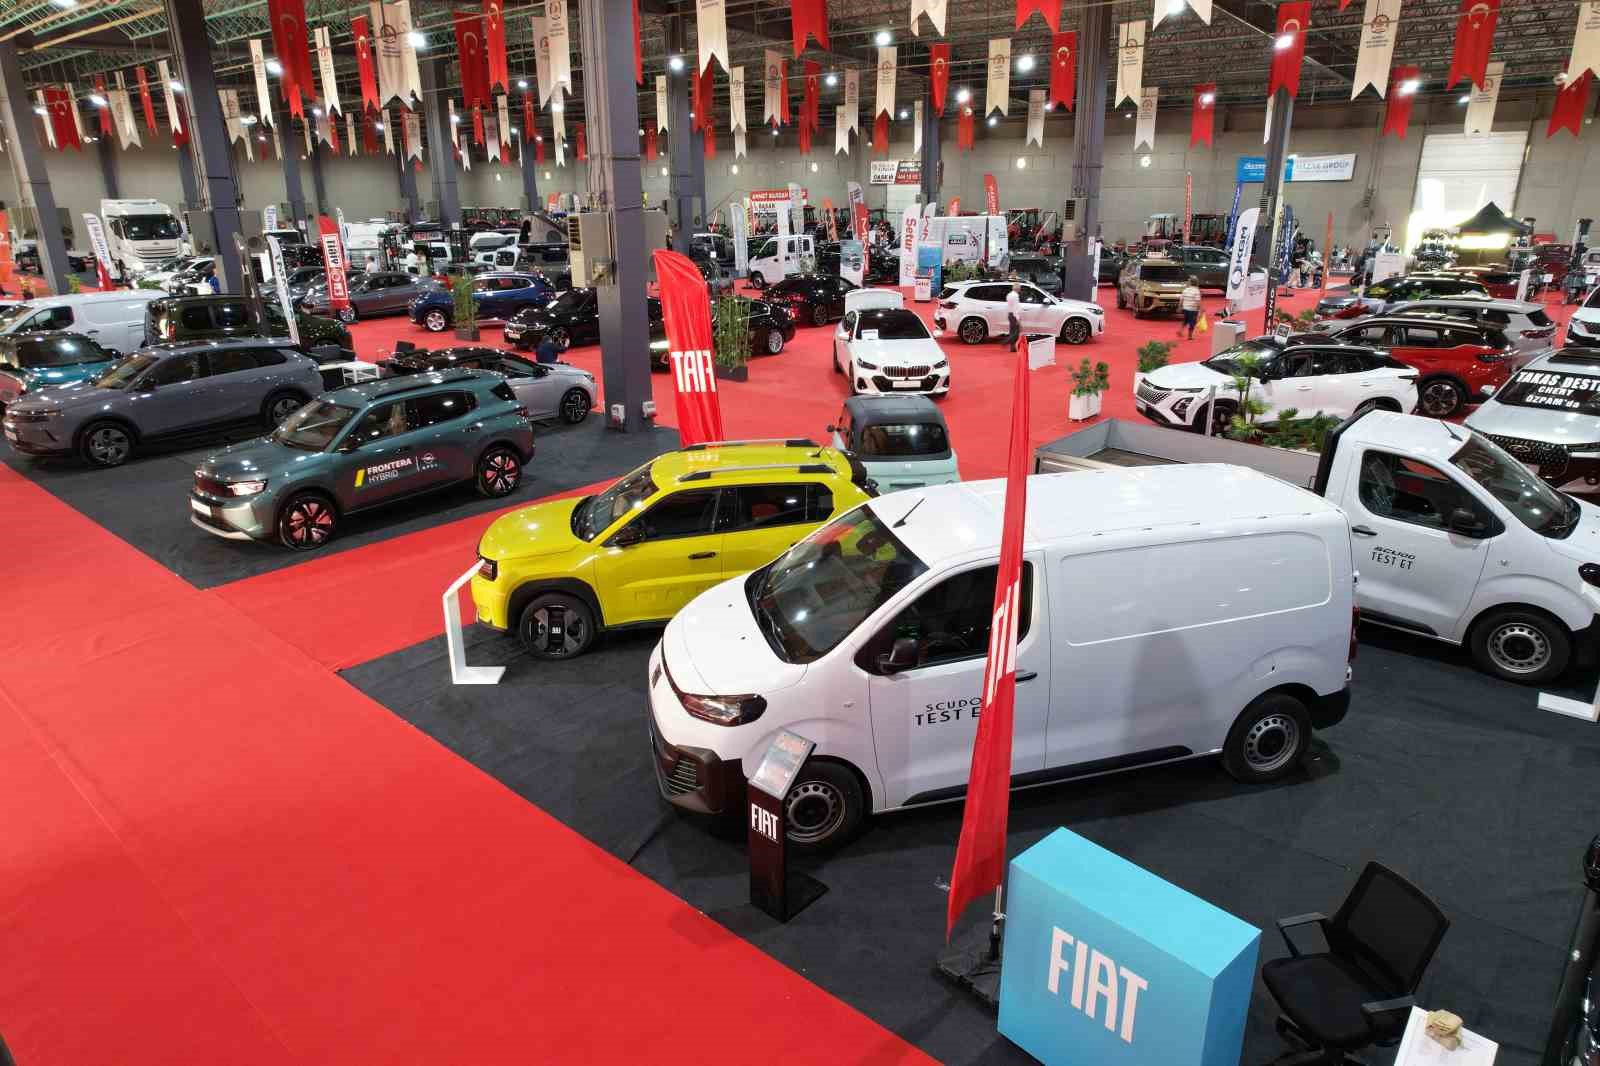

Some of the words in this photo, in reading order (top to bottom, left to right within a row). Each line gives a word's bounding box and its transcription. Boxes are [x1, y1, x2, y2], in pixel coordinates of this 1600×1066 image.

[905, 218, 917, 252] Setur
[1235, 226, 1248, 263] KGM
[1516, 371, 1560, 386] TAKAS
[1538, 386, 1575, 397] CHERY
[367, 457, 413, 475] FRONTERA
[368, 469, 399, 483] HYBRID
[1372, 551, 1397, 566] TEST
[1400, 559, 1413, 570] ET
[1373, 546, 1416, 560] SCUDO
[926, 697, 982, 712] SCUDO
[915, 709, 962, 726] TEST
[751, 803, 779, 841] FIAT
[1047, 926, 1149, 1043] FIAT
